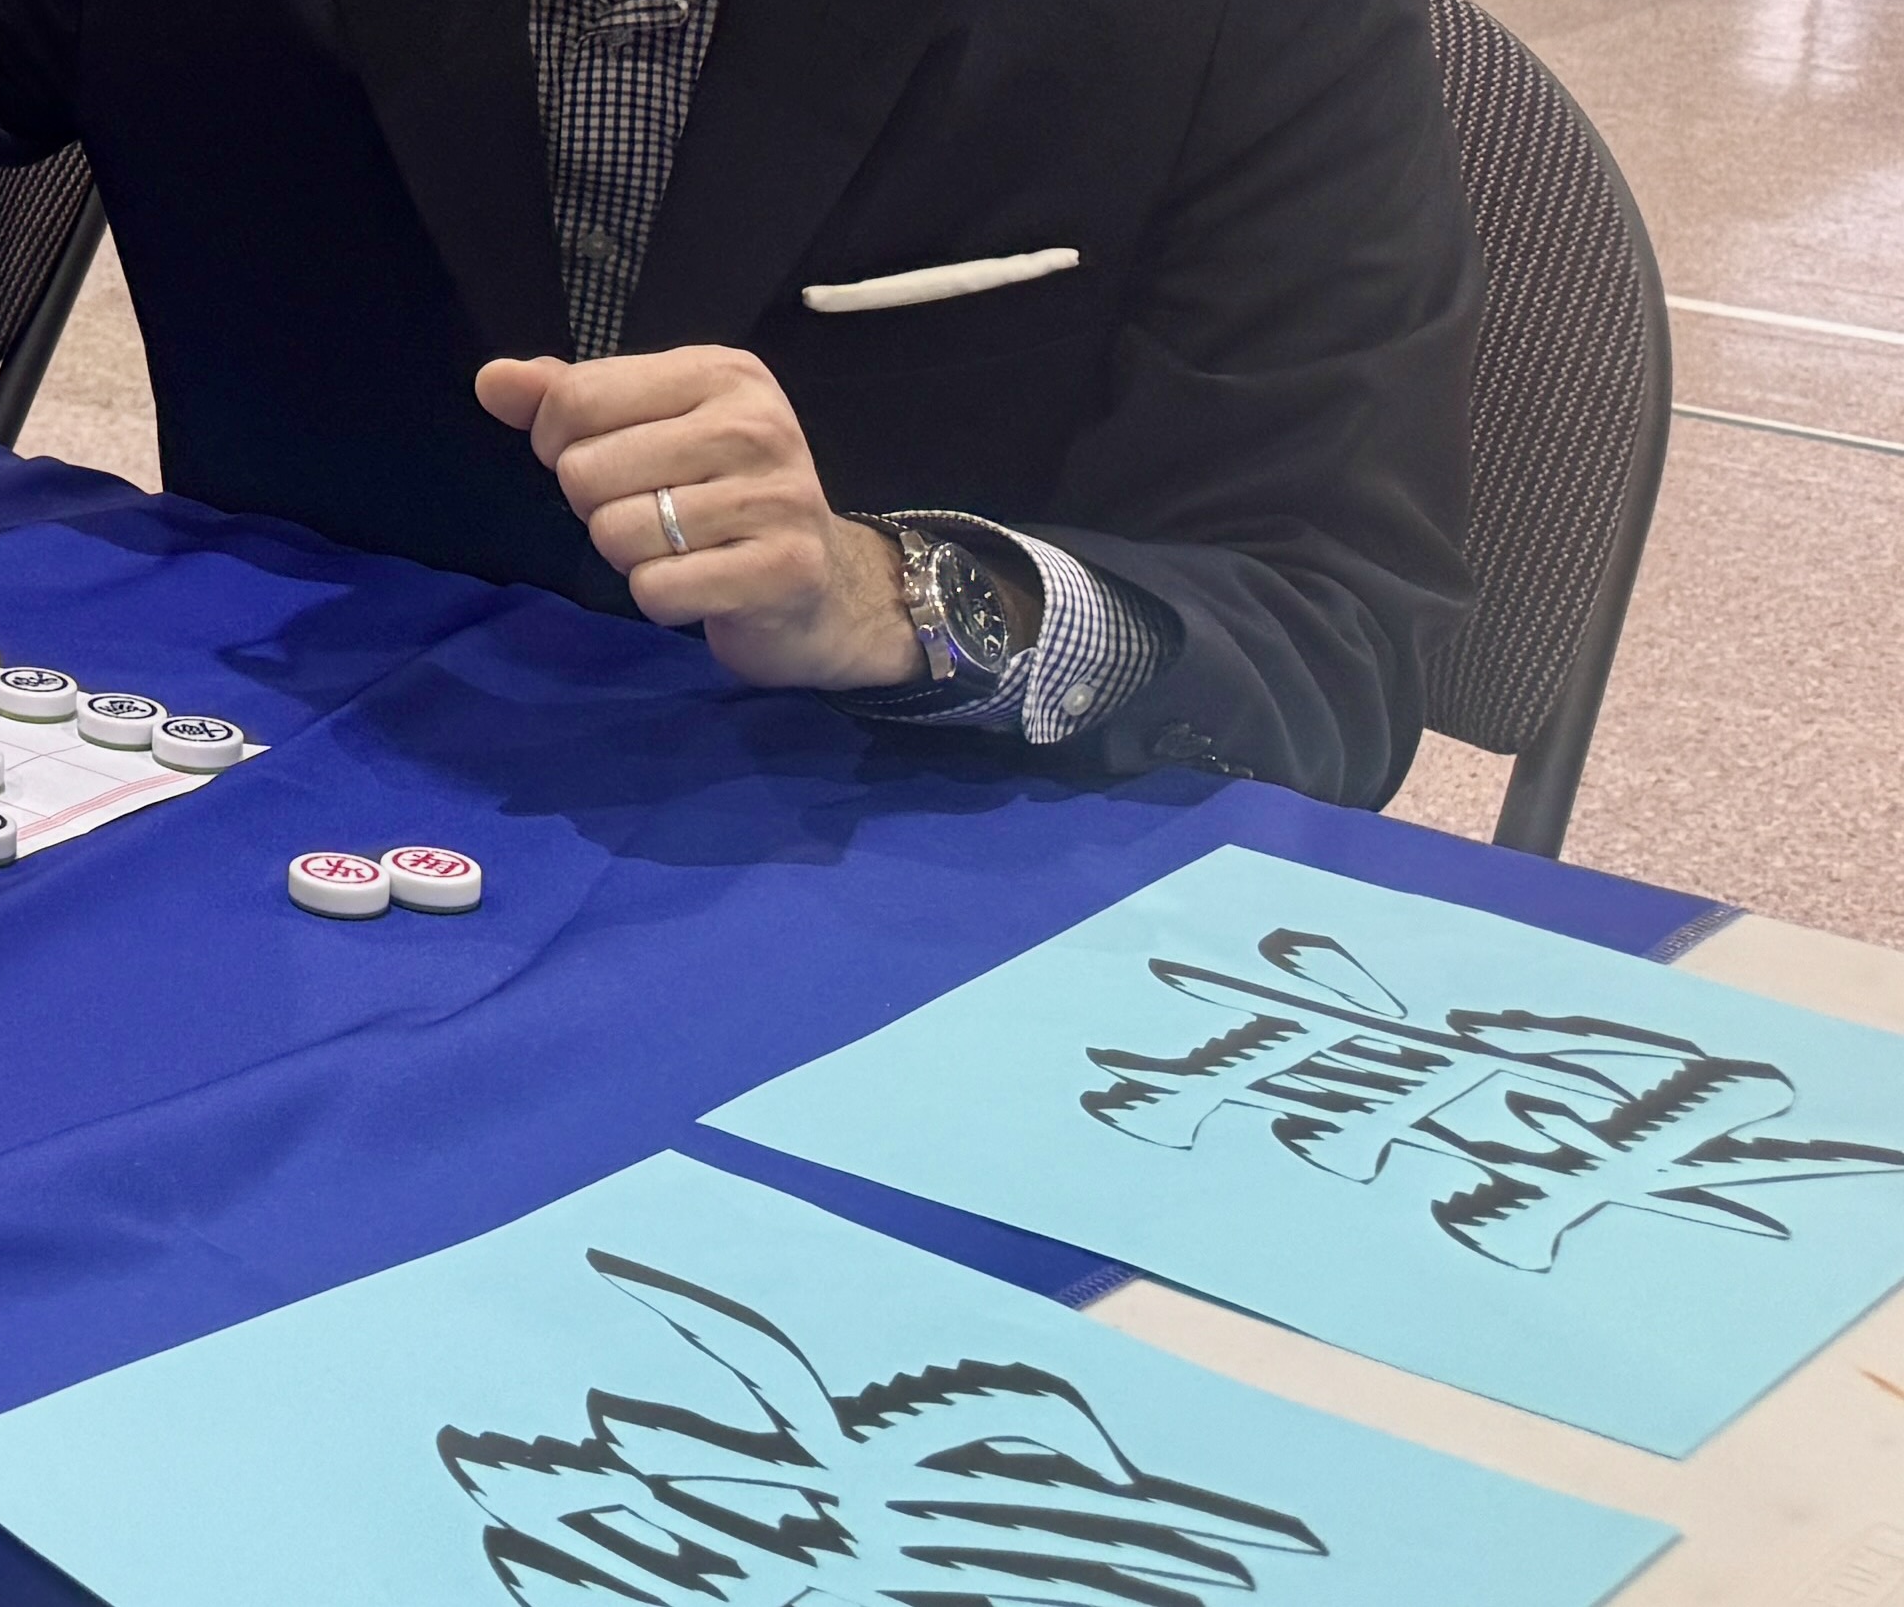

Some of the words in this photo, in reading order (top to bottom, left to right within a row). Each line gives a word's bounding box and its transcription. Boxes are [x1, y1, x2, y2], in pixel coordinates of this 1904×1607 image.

[308, 858, 370, 880] 兵
[400, 852, 462, 874] 相
[1079, 926, 1904, 1276] 棋
